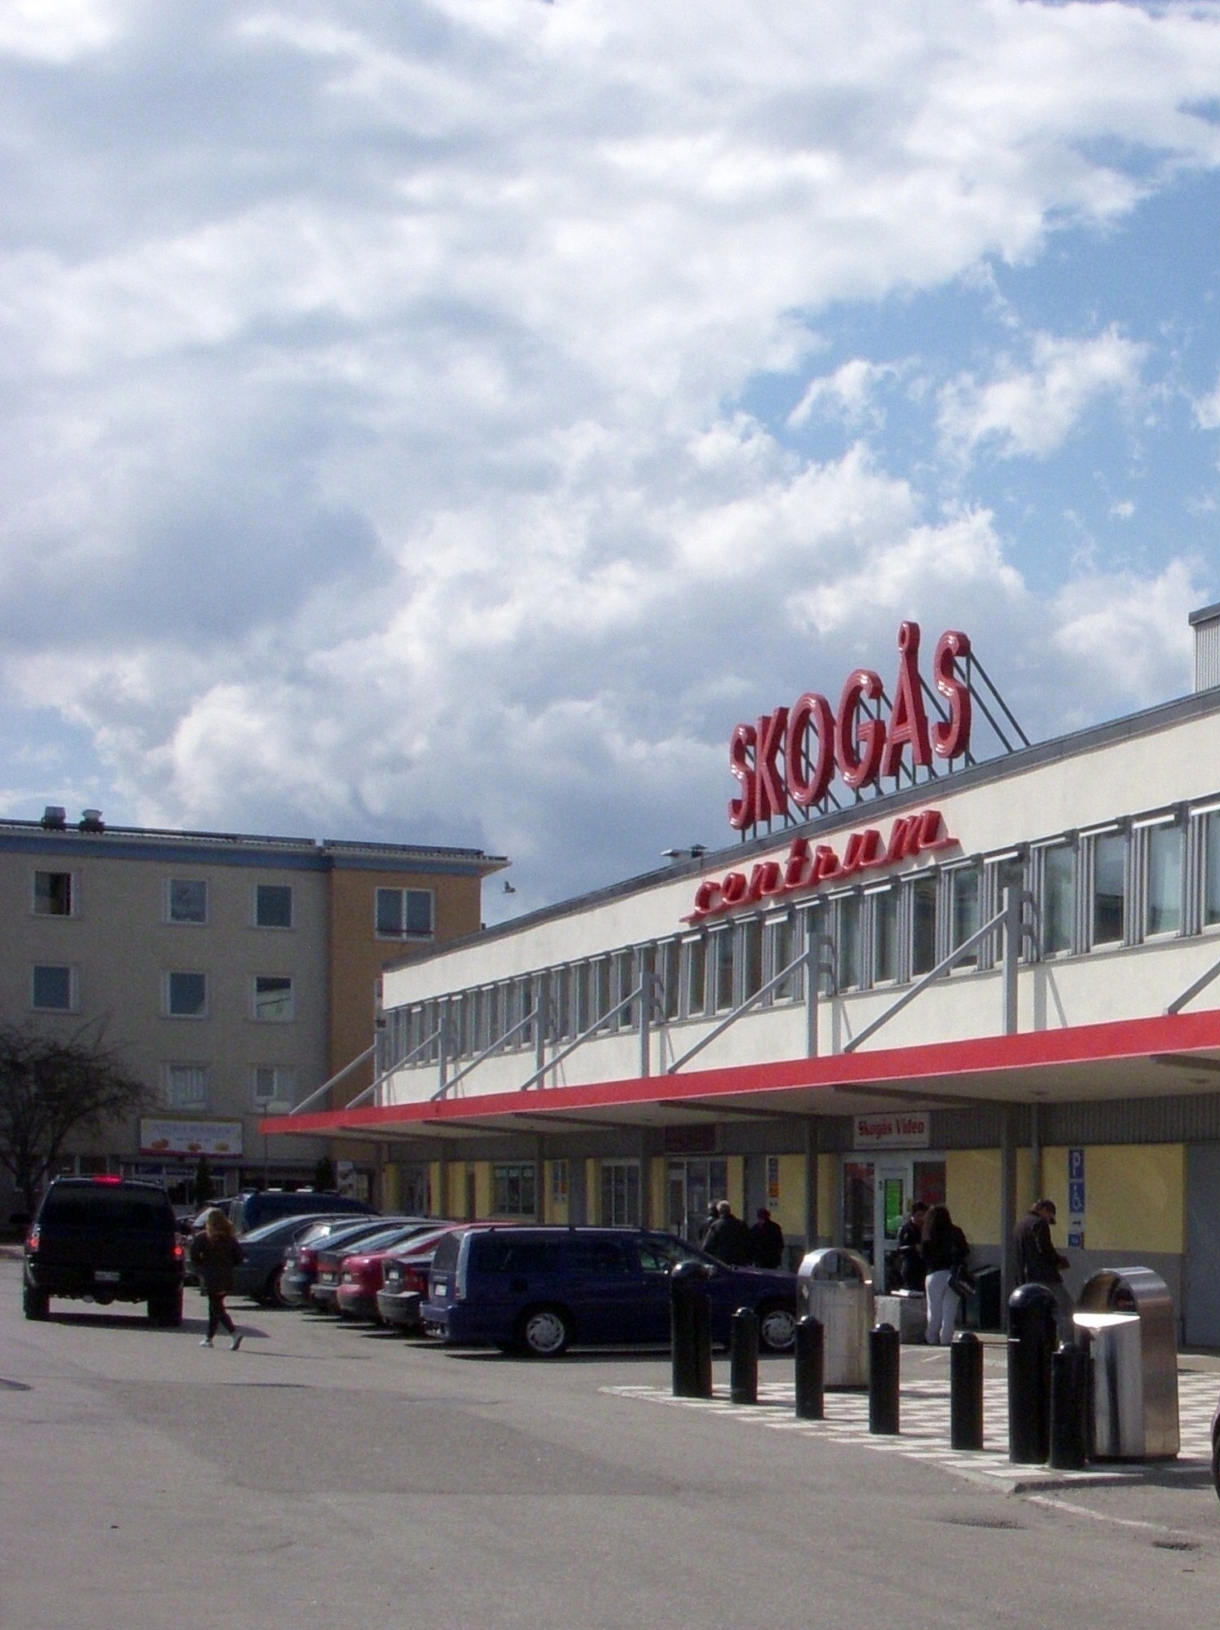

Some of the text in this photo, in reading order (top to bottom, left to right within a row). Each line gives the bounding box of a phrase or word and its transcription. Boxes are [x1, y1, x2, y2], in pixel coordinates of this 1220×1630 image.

[727, 619, 973, 830] SKOGÅS
[679, 810, 961, 923] centrum
[858, 1119, 925, 1139] Skogås Video
